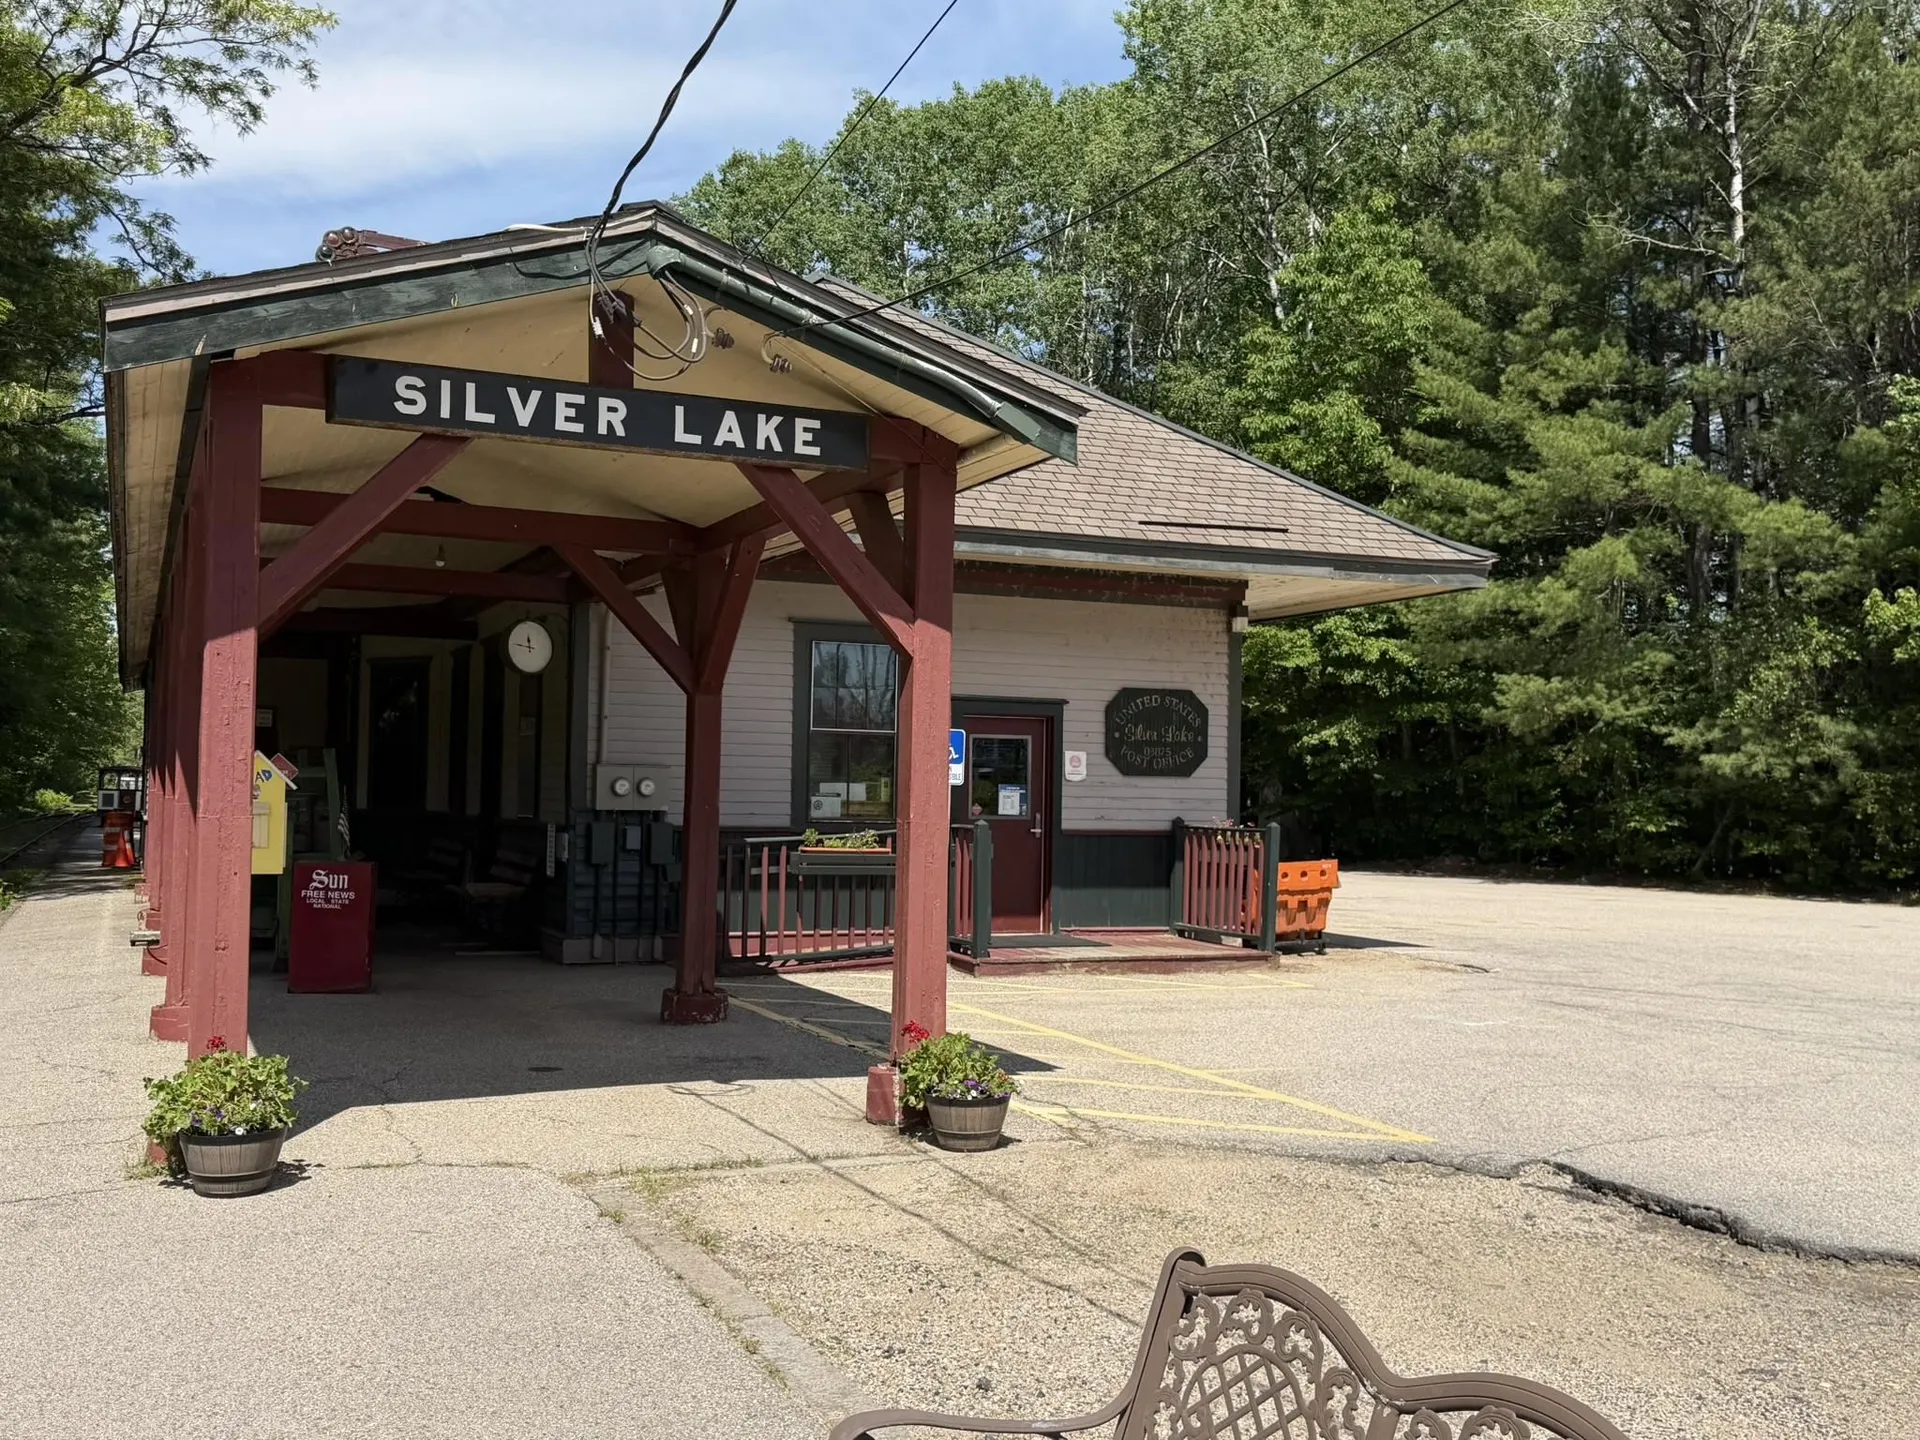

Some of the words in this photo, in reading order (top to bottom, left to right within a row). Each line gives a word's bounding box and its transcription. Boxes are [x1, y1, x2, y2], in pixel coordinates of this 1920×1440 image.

[393, 375, 628, 438] SILVER
[673, 405, 823, 456] LAKE
[1115, 694, 1161, 725] UNITED
[1163, 695, 1202, 728] STATES
[1120, 745, 1152, 767] POST
[1153, 747, 1195, 770] OFFICE
[309, 869, 349, 890] Sun
[301, 889, 326, 898] FREE
[327, 891, 356, 900] NEWS
